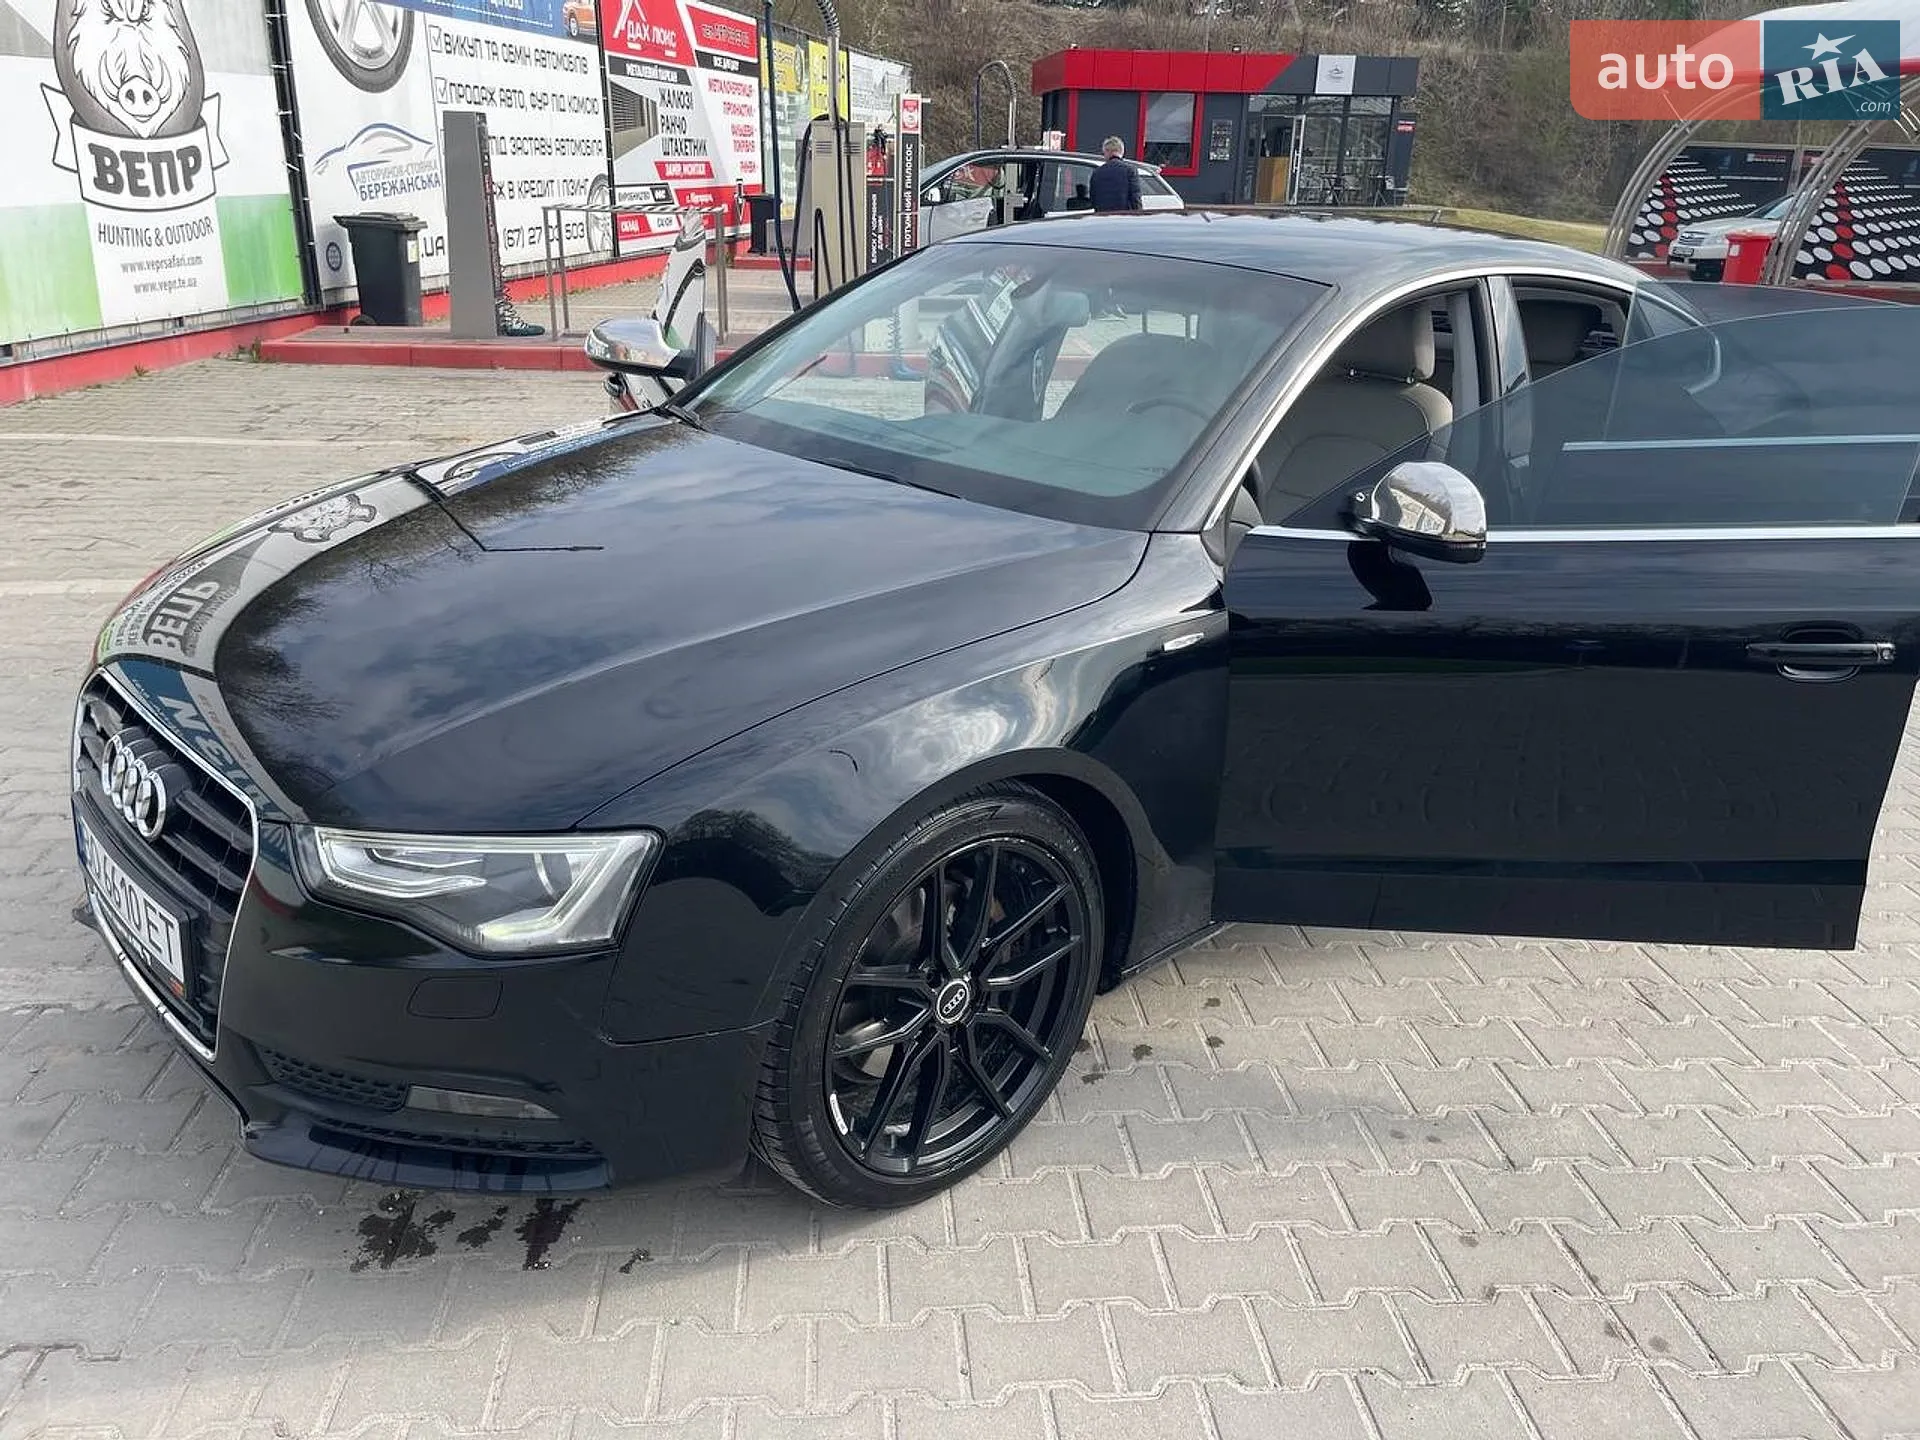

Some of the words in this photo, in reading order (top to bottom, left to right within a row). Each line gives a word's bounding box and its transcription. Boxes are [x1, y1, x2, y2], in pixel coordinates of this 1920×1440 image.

[627, 20, 650, 42] ДАХ
[444, 33, 482, 59] ВИКУП
[485, 40, 499, 61] ТА
[502, 43, 532, 67] ОБМІН
[450, 83, 497, 107] ПРОДАЖ
[659, 115, 687, 135] РАНЧО
[661, 137, 708, 157] ШТАКЕТНИК
[88, 142, 202, 197] ВЕПР
[360, 172, 441, 201] БЕРЕЖАНСЬКА
[519, 180, 554, 198] КРЕДИТ
[98, 222, 152, 247] HUNTING
[154, 227, 164, 246] &
[165, 215, 214, 244] OUTDOOR
[528, 226, 543, 245] 27
[120, 254, 203, 273] www.veprsafari.com
[103, 855, 141, 931] 6610
[144, 897, 174, 965] ET
